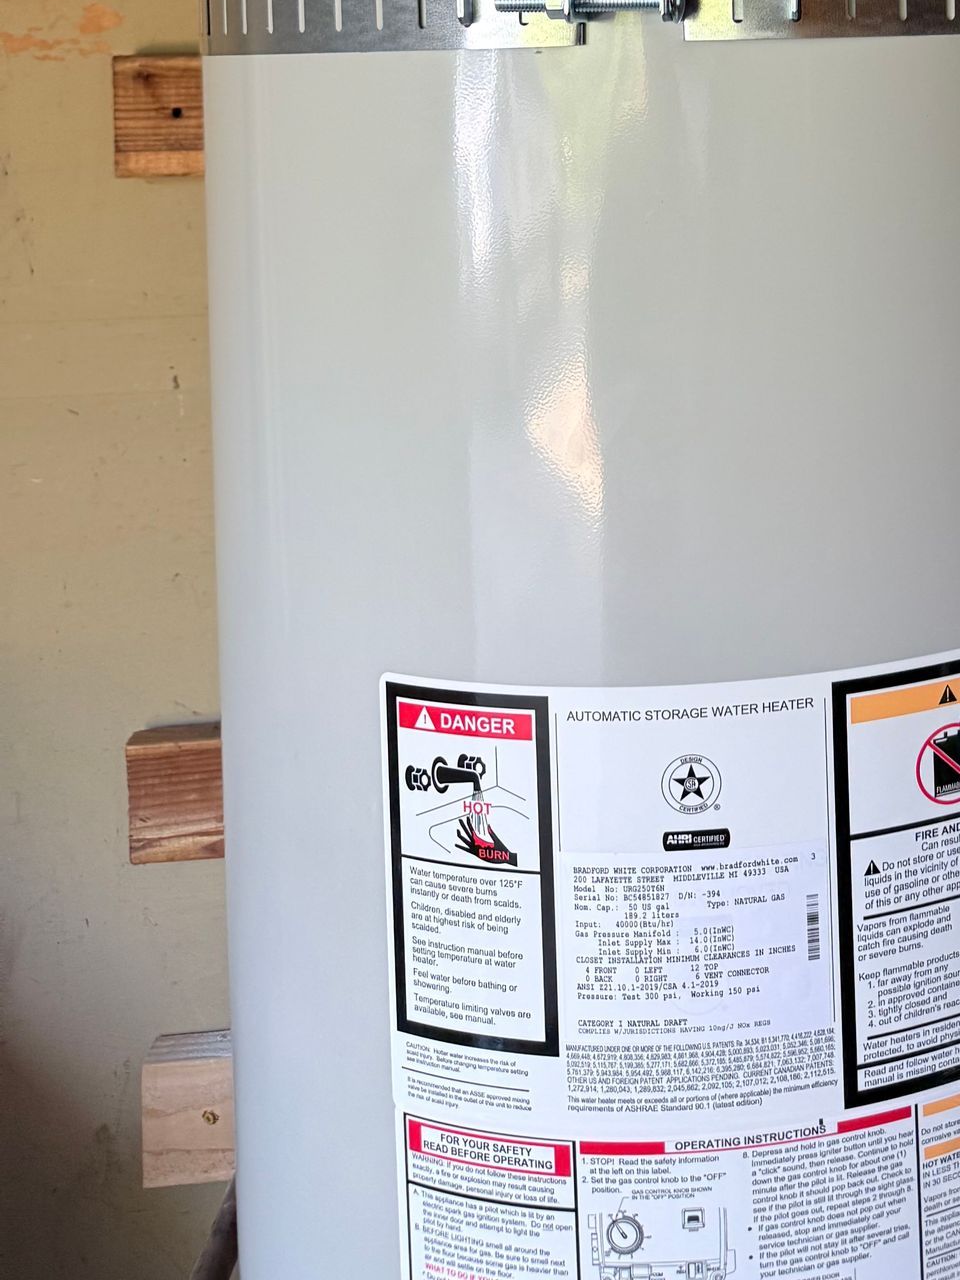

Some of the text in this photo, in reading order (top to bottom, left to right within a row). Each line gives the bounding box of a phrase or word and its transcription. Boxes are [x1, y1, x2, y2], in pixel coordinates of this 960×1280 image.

[566, 698, 814, 722] AUTOMATIC STORAGE WATER HEATER
[440, 712, 516, 734] DANGER
[464, 800, 492, 816] HOT
[666, 834, 692, 845] AHRI
[914, 828, 939, 842] FIRE
[921, 840, 938, 852] Can
[478, 848, 510, 860] BURN
[573, 852, 816, 874] BRADFORD WHITE CORPORATION www.bradfordwhite.com 3
[410, 866, 431, 878] Water
[432, 870, 478, 886] temperature
[480, 878, 497, 887] over
[591, 876, 632, 884] LAFAYETTE
[636, 875, 665, 883] STREET
[672, 871, 725, 882] MIDDLEVILLE
[728, 870, 738, 879] MI
[743, 868, 766, 877] 49333
[774, 866, 790, 874] USA
[574, 885, 596, 893] Model
[574, 893, 601, 901] Serial
[707, 893, 786, 909] Type: NATURAL GAS
[656, 902, 670, 912] gal
[624, 911, 680, 920] 189.2 liters
[575, 921, 601, 930] Input:
[575, 930, 589, 938] Gas
[593, 930, 630, 938] Pressure
[634, 930, 671, 938] Manifold
[625, 939, 653, 948] Supply
[576, 944, 796, 964] CLOSET INSTALLATION MINIMUM CLEARANCES IN INCHES
[644, 966, 663, 974] LEFT
[704, 963, 719, 971] TOP
[695, 972, 700, 980] 6
[704, 971, 724, 979] VENT
[727, 966, 770, 978] CONNECTOR
[577, 983, 595, 991] ANSI
[577, 992, 616, 1000] Pressure:
[645, 992, 659, 1000] 300
[690, 989, 724, 998] Working
[728, 987, 742, 995] 150
[746, 985, 760, 996] psi
[674, 1124, 826, 1151] OPERATING INSTRUCTIONS
[440, 1133, 532, 1158] FOR YOUR SAFETY
[423, 1140, 553, 1170] READ BEFORE OPERATING
